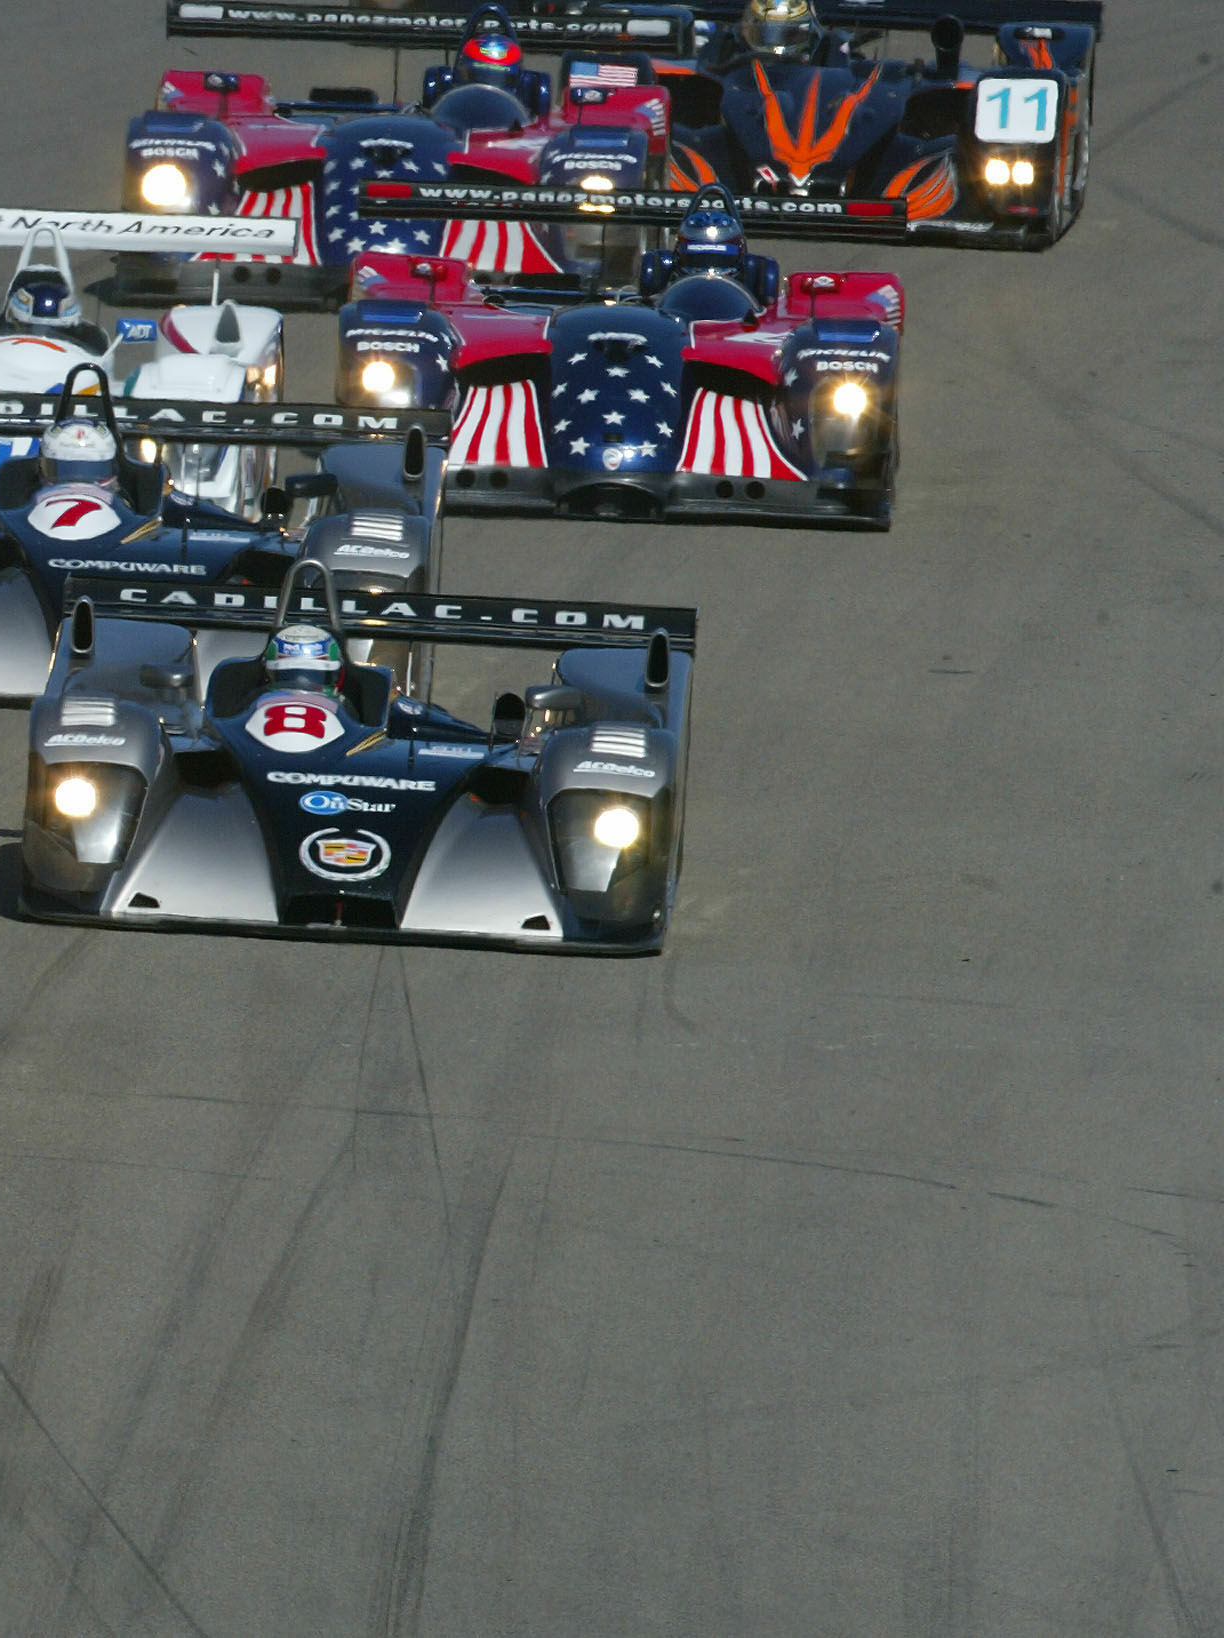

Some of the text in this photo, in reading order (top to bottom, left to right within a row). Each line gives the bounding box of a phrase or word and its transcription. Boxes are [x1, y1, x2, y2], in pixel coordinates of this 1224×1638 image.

[228, 9, 623, 33] www.panozmotorprts.com
[985, 87, 1048, 131] 11
[142, 148, 198, 160] BOSCH
[564, 160, 622, 171] BOSCH
[118, 220, 276, 239] America
[127, 323, 152, 339] ADT
[357, 341, 420, 353] BOSCH
[797, 348, 891, 363] MICHELIN
[816, 361, 879, 374] BOSCH
[45, 498, 102, 529] 7
[48, 558, 207, 576] COMPUWARE
[121, 588, 644, 630] CADILLAC.COM
[264, 704, 326, 739] 8
[267, 771, 436, 792] COMPUWARE
[304, 793, 396, 813] OnStar
